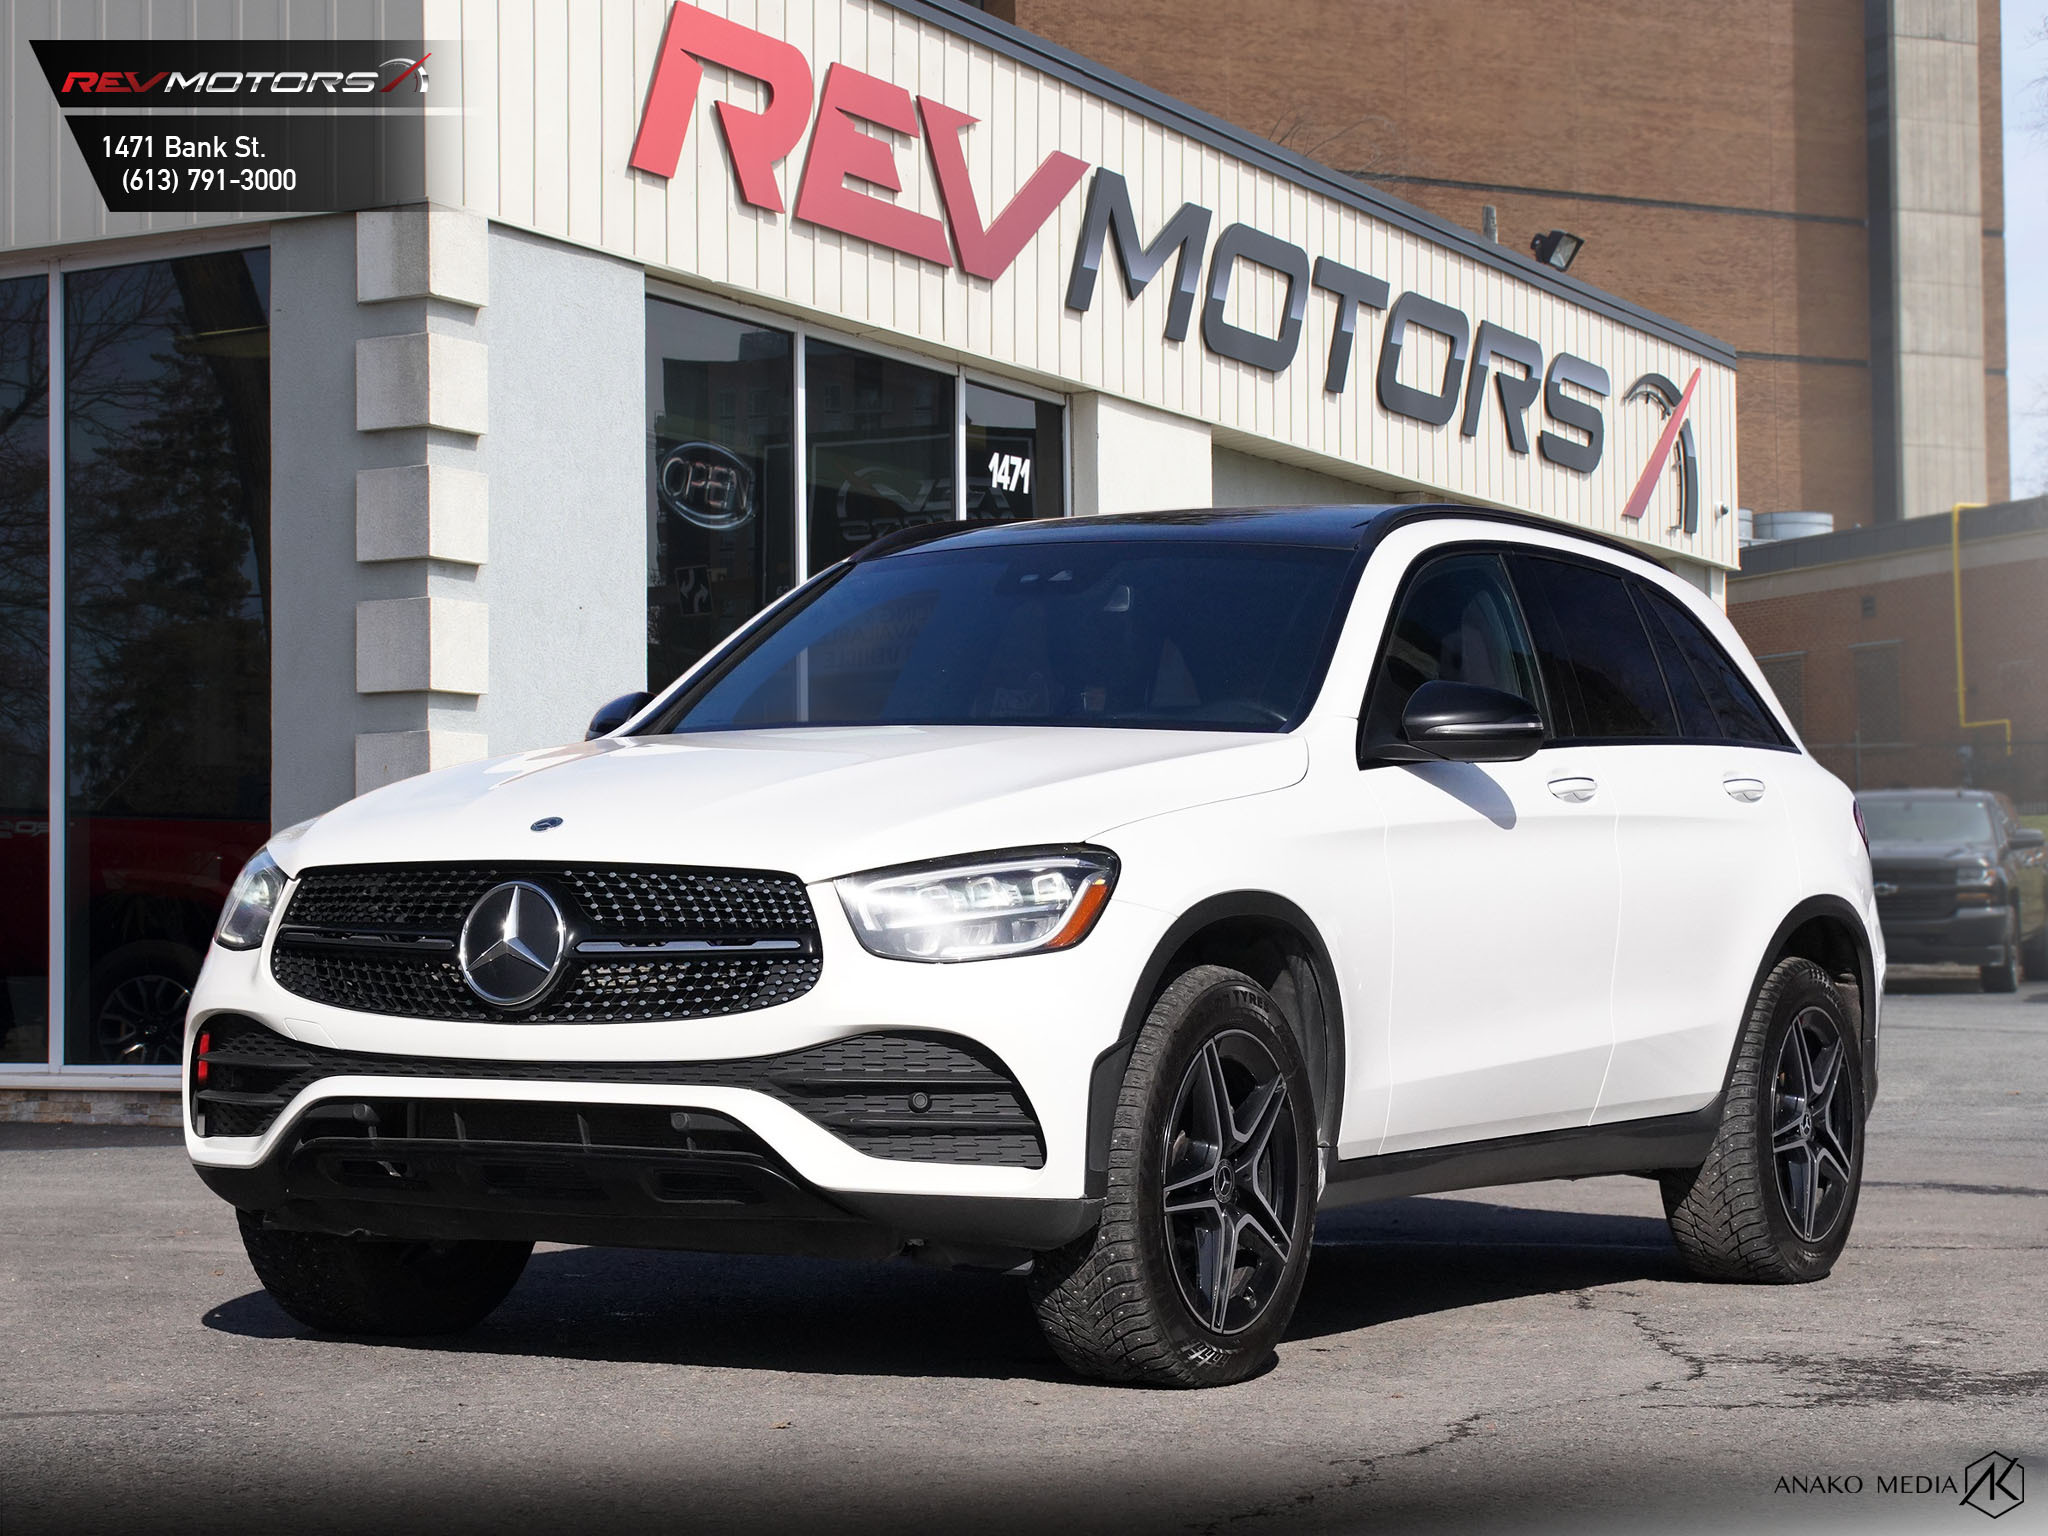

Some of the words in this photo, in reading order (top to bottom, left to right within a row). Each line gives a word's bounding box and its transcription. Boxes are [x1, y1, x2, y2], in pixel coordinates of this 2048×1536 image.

[662, 457, 750, 512] OPEN
[988, 452, 1031, 494] 1471
[1232, 990, 1270, 1013] TYRES
